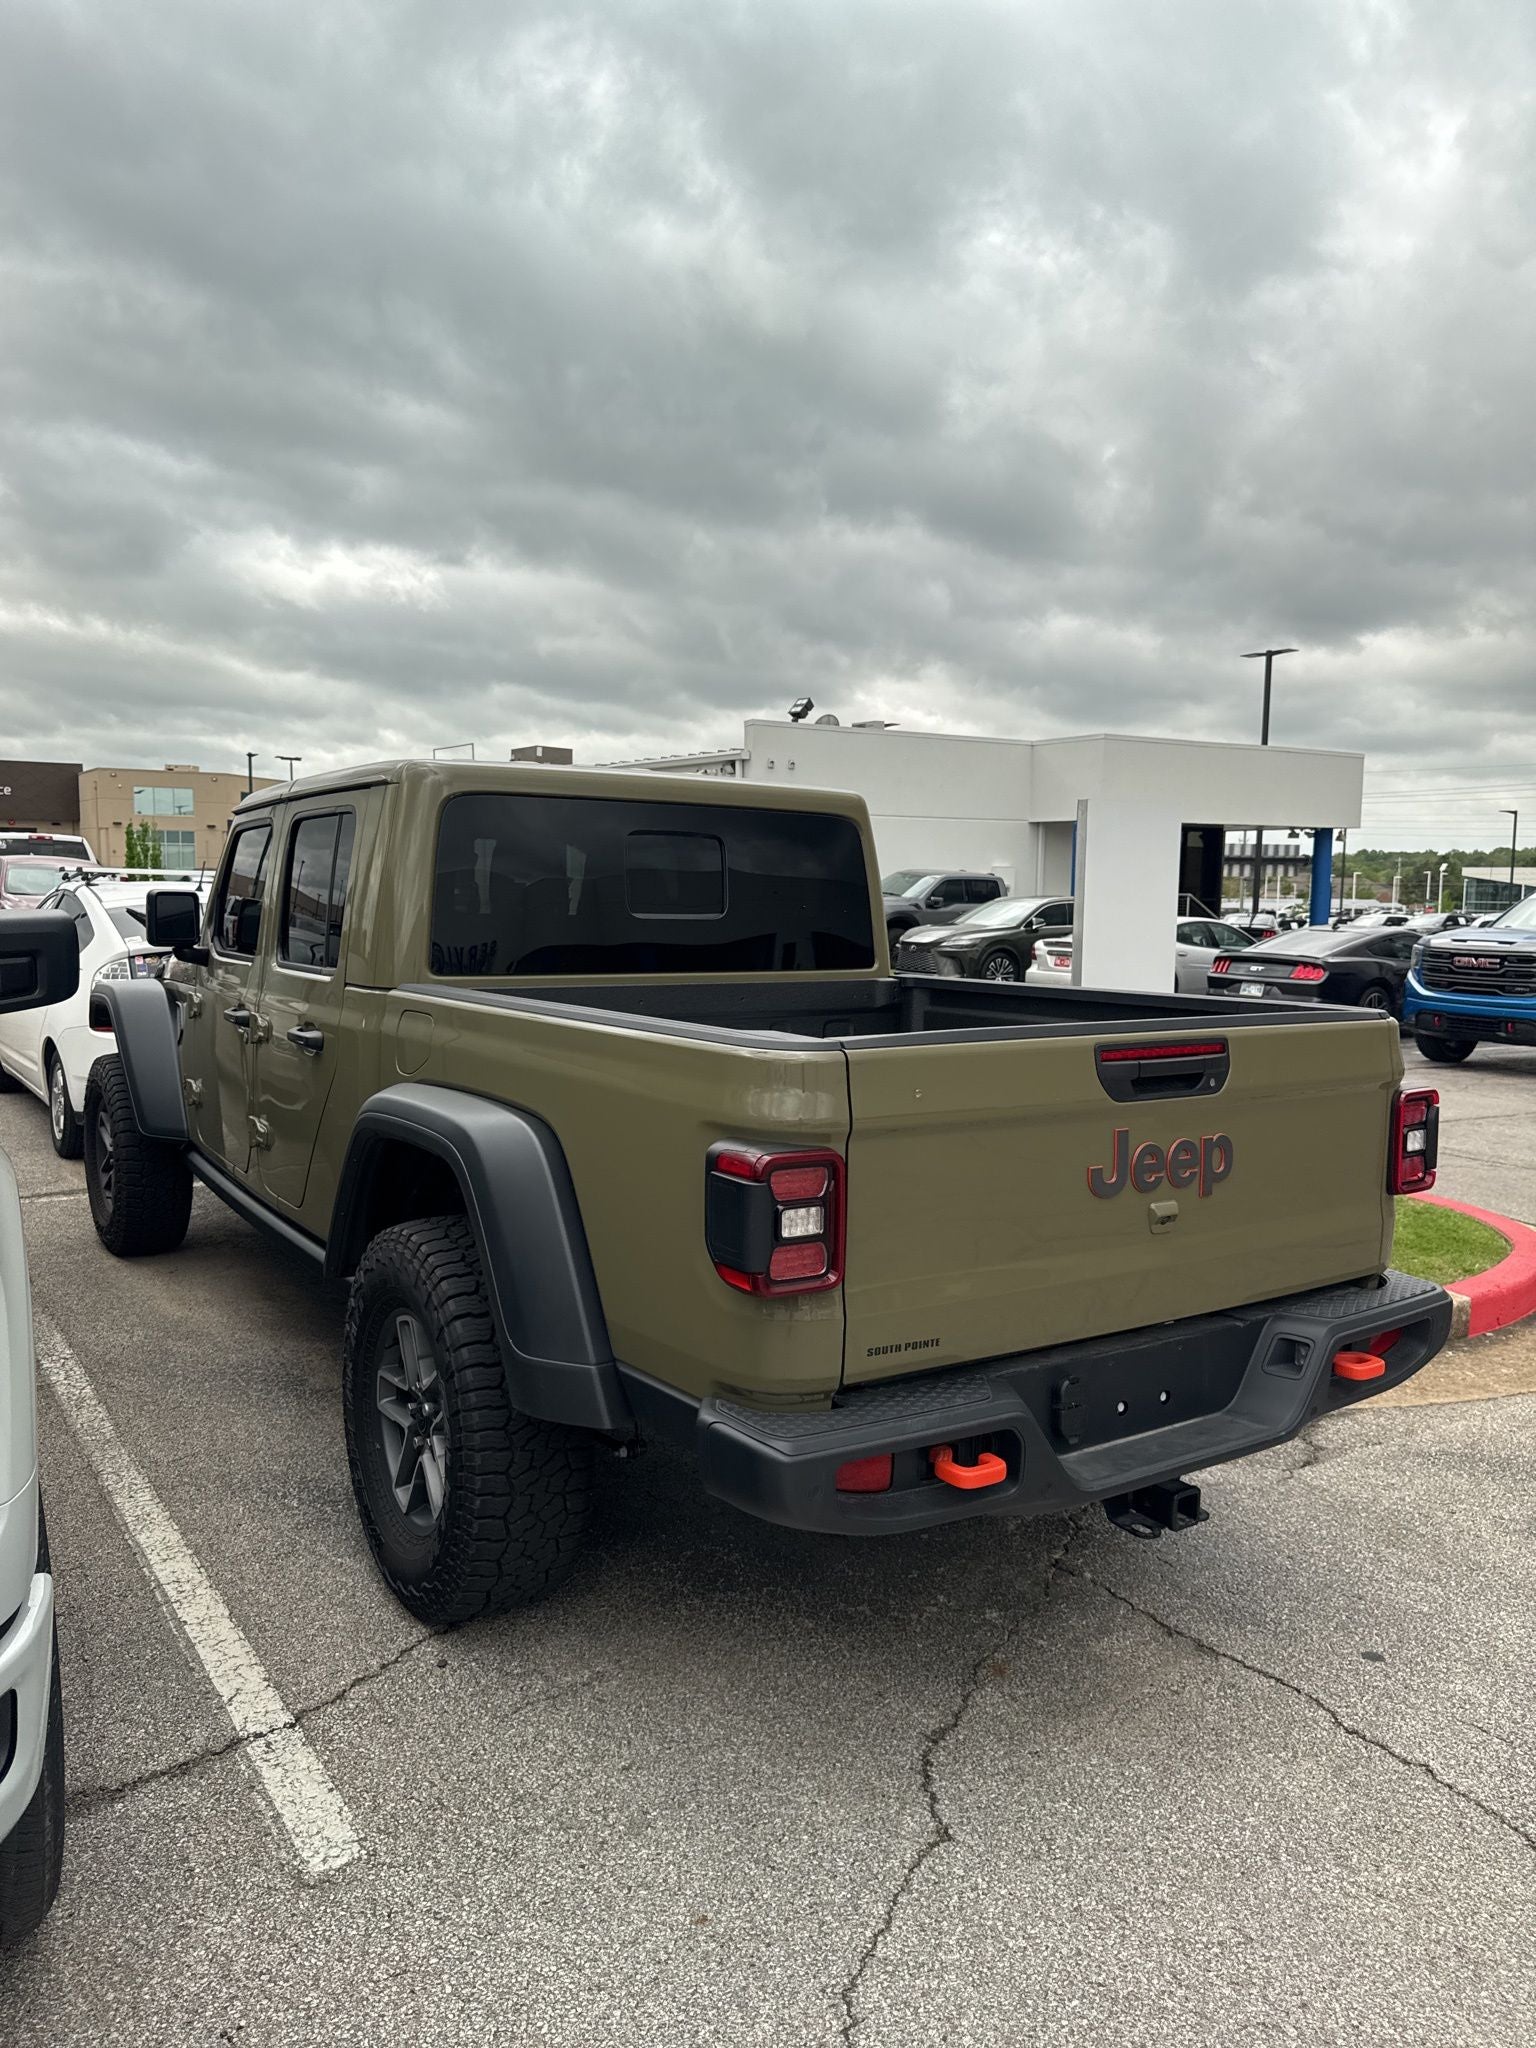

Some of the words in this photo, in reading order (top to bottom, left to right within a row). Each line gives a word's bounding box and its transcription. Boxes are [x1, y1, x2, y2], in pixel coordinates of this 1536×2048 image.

[1453, 956, 1501, 969] GMC
[1087, 1127, 1234, 1200] Jeep
[866, 1343, 902, 1357] SOUTH
[904, 1337, 941, 1352] POINTE
